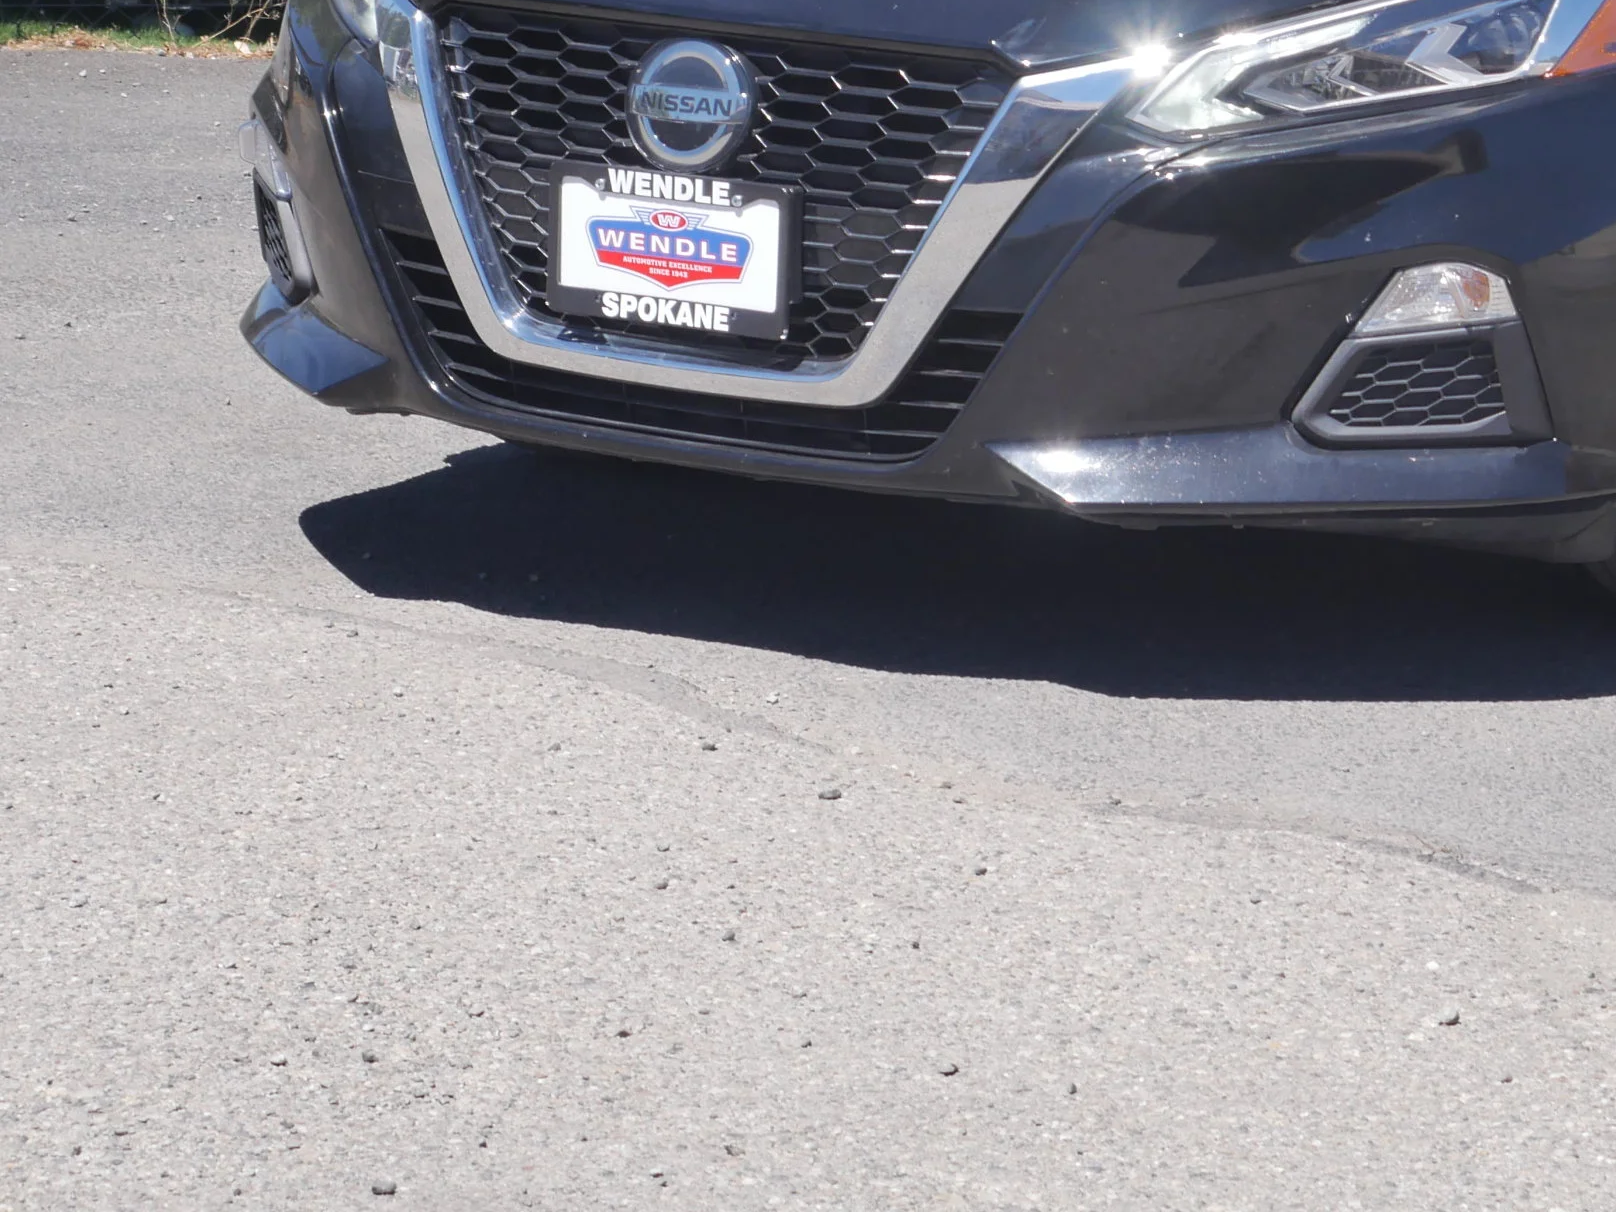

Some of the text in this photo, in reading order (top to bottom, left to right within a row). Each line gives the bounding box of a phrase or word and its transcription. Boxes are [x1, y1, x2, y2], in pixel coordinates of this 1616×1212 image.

[641, 91, 733, 117] NISSAN
[607, 168, 731, 206] WENDLE
[597, 228, 738, 262] WENDLE
[622, 255, 712, 274] AUTOMOTIVE EXCELLENCE
[649, 267, 670, 277] SINCE
[601, 291, 730, 332] SPOKANE
